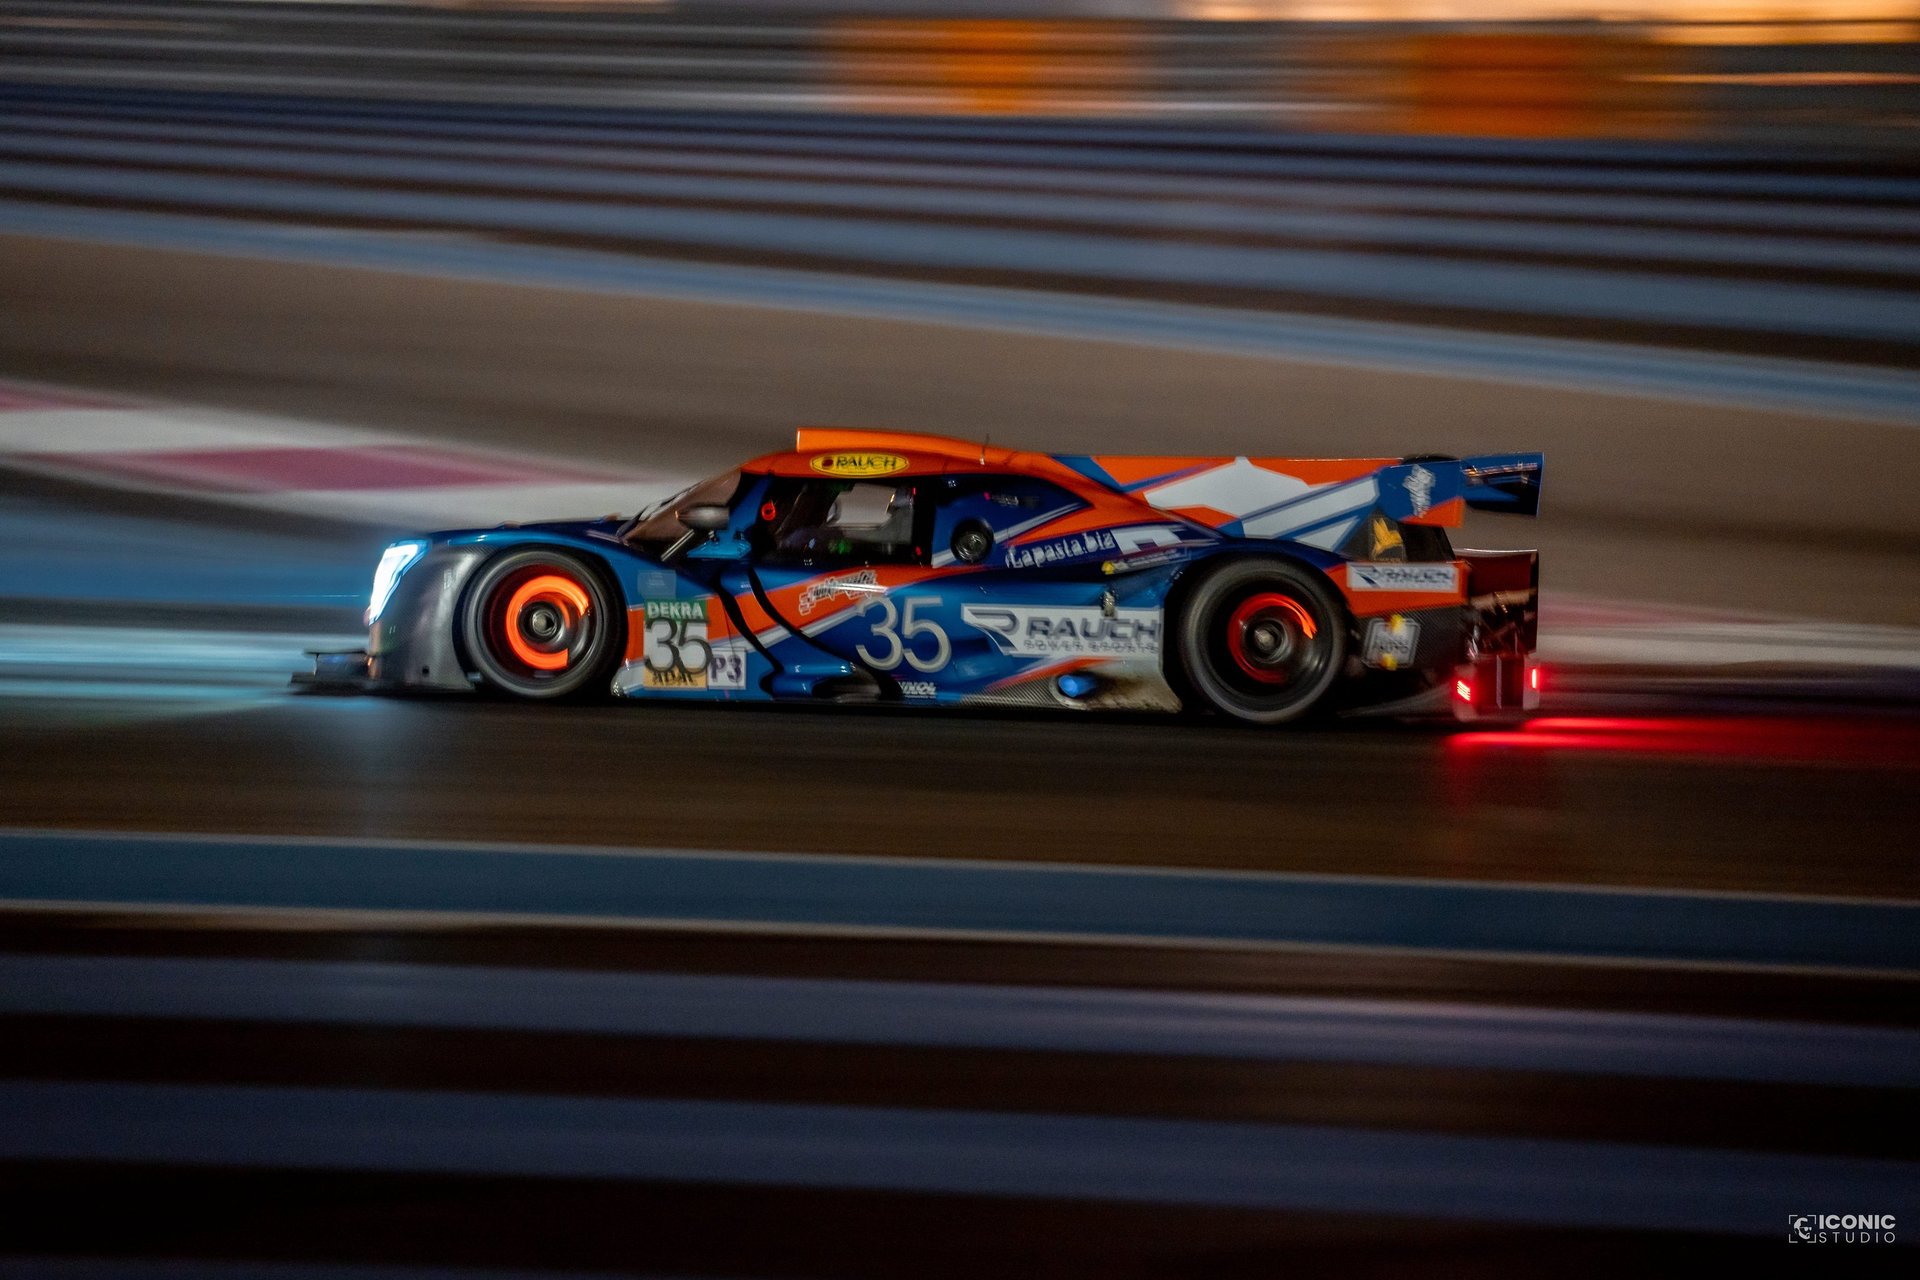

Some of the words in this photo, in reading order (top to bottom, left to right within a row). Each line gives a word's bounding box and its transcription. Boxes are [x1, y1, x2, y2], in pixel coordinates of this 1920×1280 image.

[647, 601, 705, 620] DEKRA
[856, 596, 952, 672] 35
[1025, 616, 1161, 641] RAUCH
[644, 617, 714, 675] 35
[711, 654, 743, 683] P3
